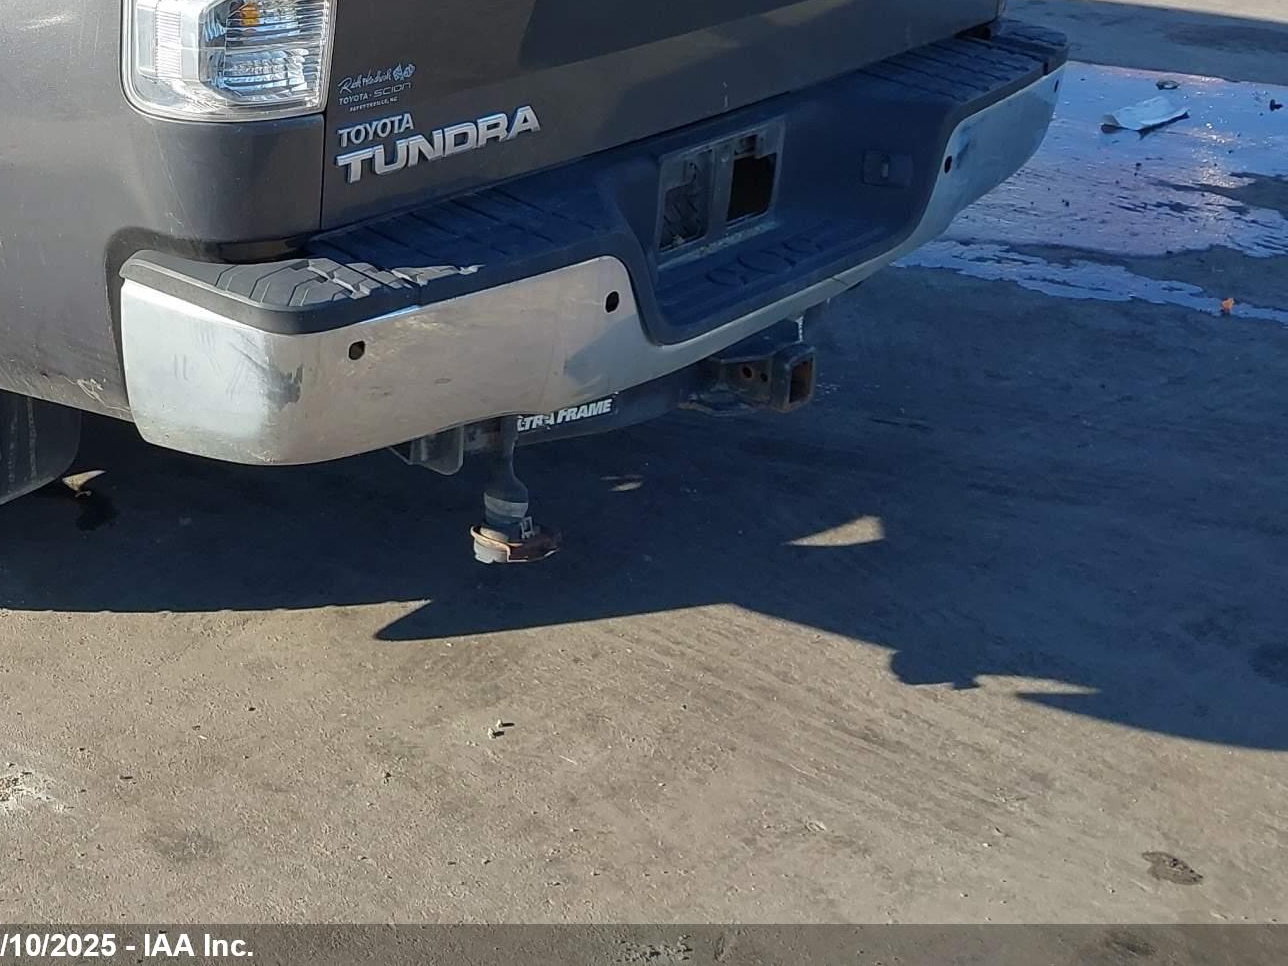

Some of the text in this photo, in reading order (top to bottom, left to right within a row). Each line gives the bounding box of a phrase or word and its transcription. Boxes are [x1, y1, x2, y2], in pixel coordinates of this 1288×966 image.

[339, 92, 369, 106] TOYOTA
[336, 105, 541, 184] TUNDRA
[337, 113, 414, 148] TOYOTA
[557, 398, 612, 423] FRAME
